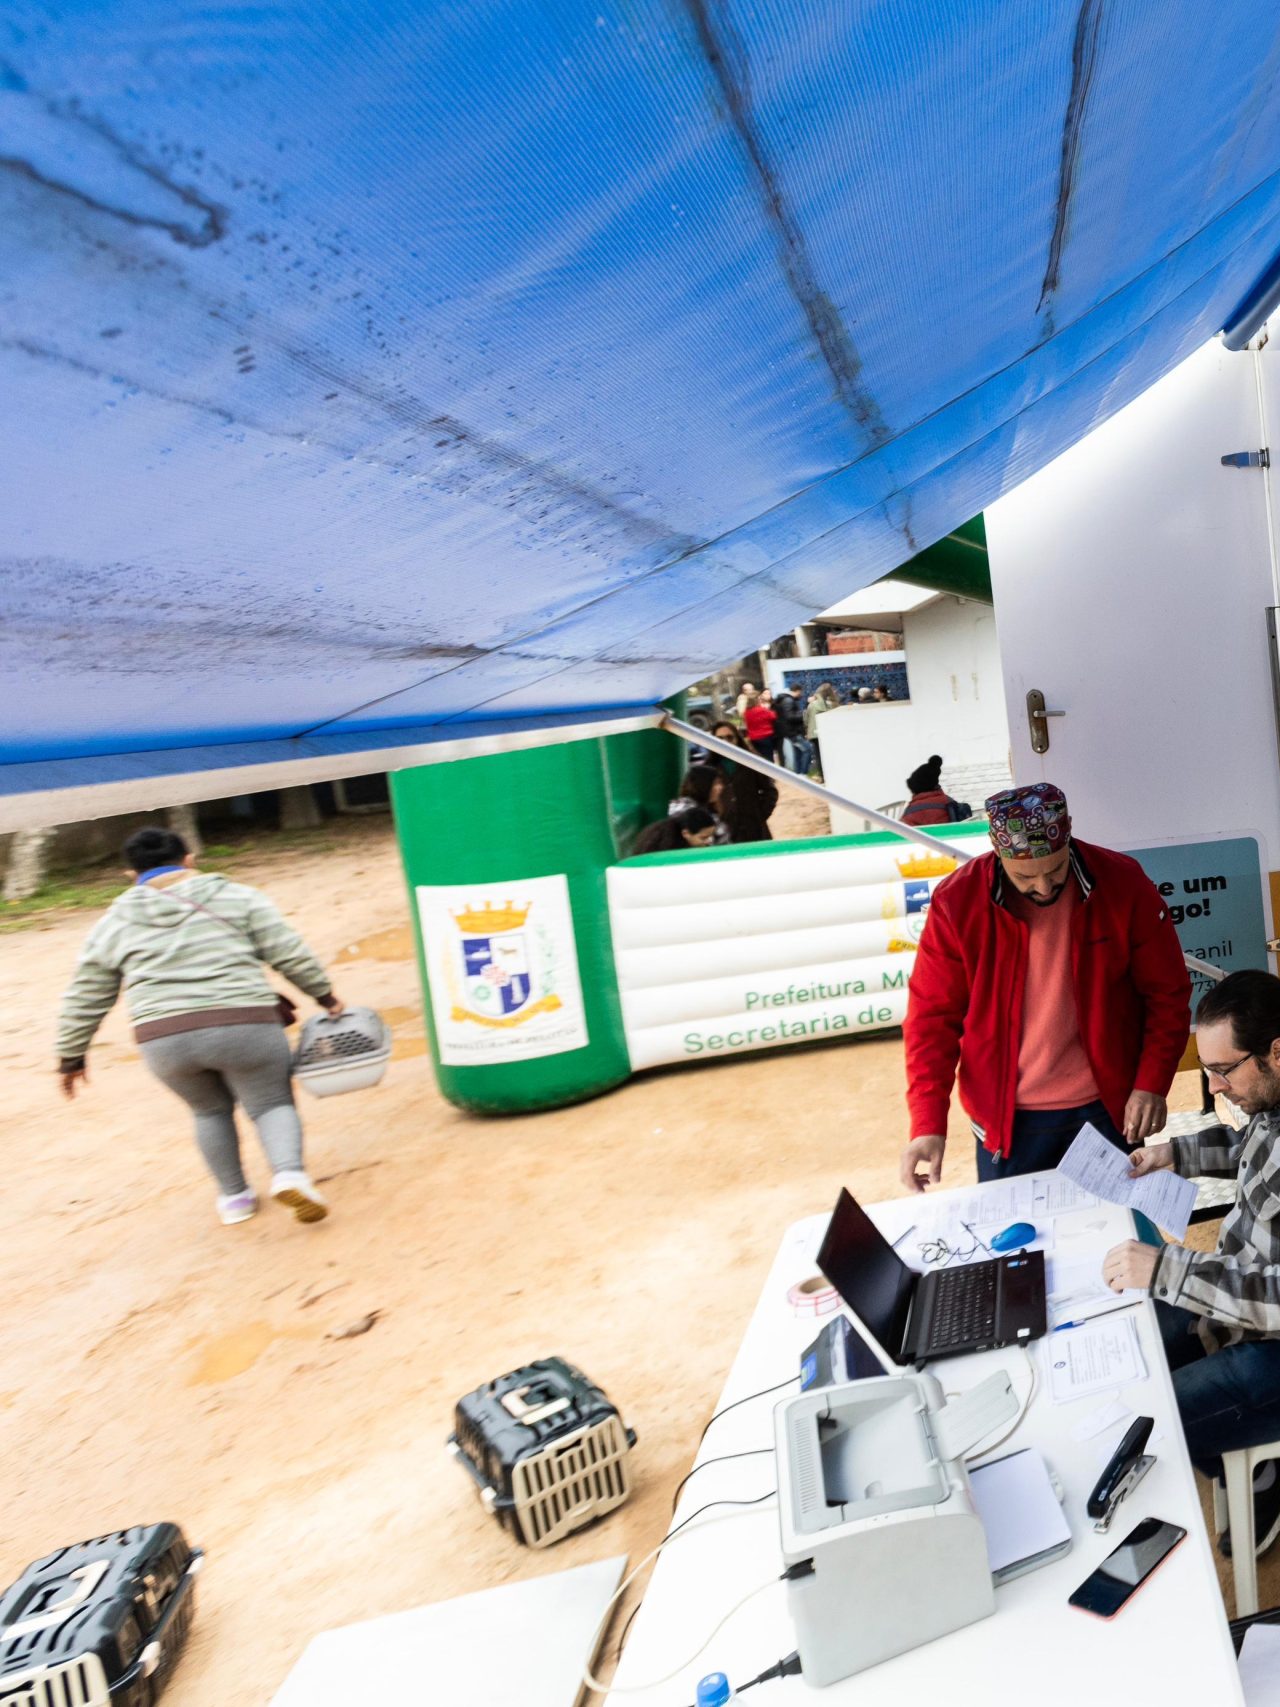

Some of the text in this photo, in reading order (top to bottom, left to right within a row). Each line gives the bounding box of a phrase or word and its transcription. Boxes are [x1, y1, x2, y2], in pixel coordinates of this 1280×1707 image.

[1183, 875, 1227, 894] um
[744, 980, 866, 1011] Prefeitura
[683, 1005, 893, 1054] Secretaria de
